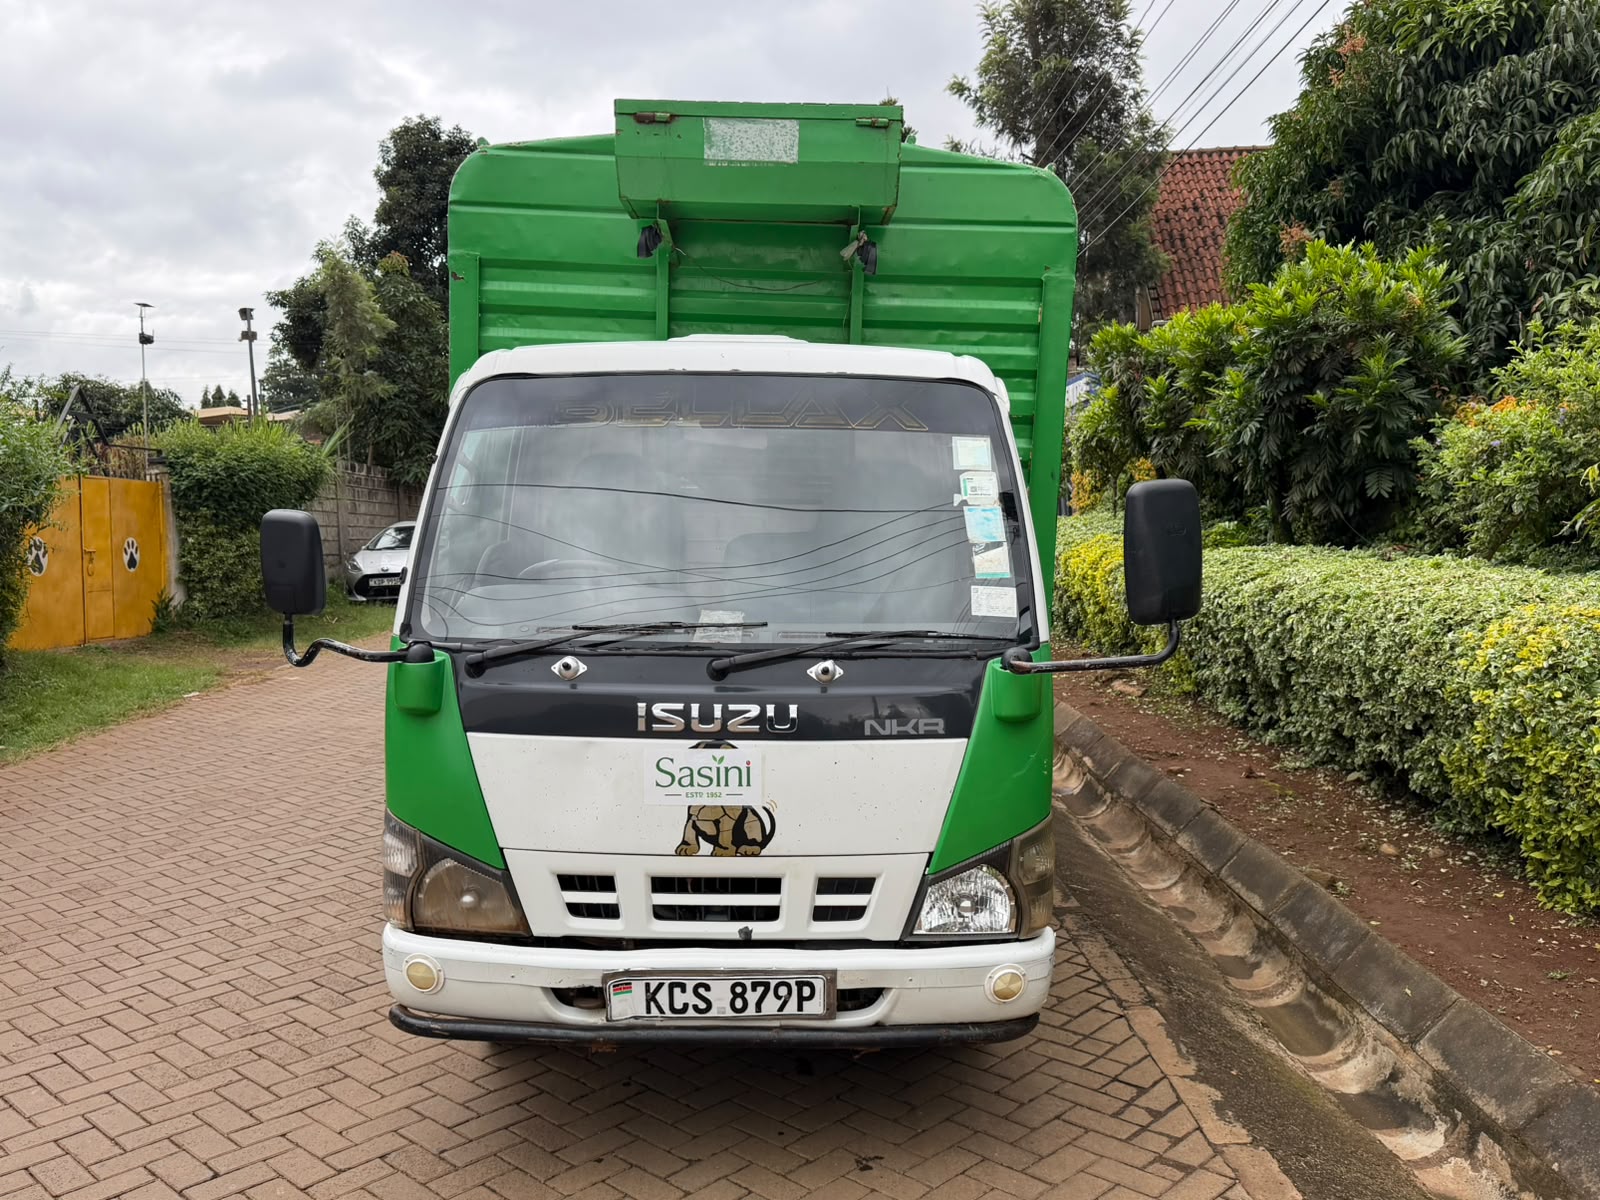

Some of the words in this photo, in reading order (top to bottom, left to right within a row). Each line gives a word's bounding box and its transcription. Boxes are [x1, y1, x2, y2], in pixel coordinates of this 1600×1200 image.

[636, 702, 799, 734] ISUZU
[863, 717, 946, 737] NKR
[655, 755, 752, 788] Sasini
[644, 981, 713, 1015] KCS
[729, 980, 816, 1015] 879P
